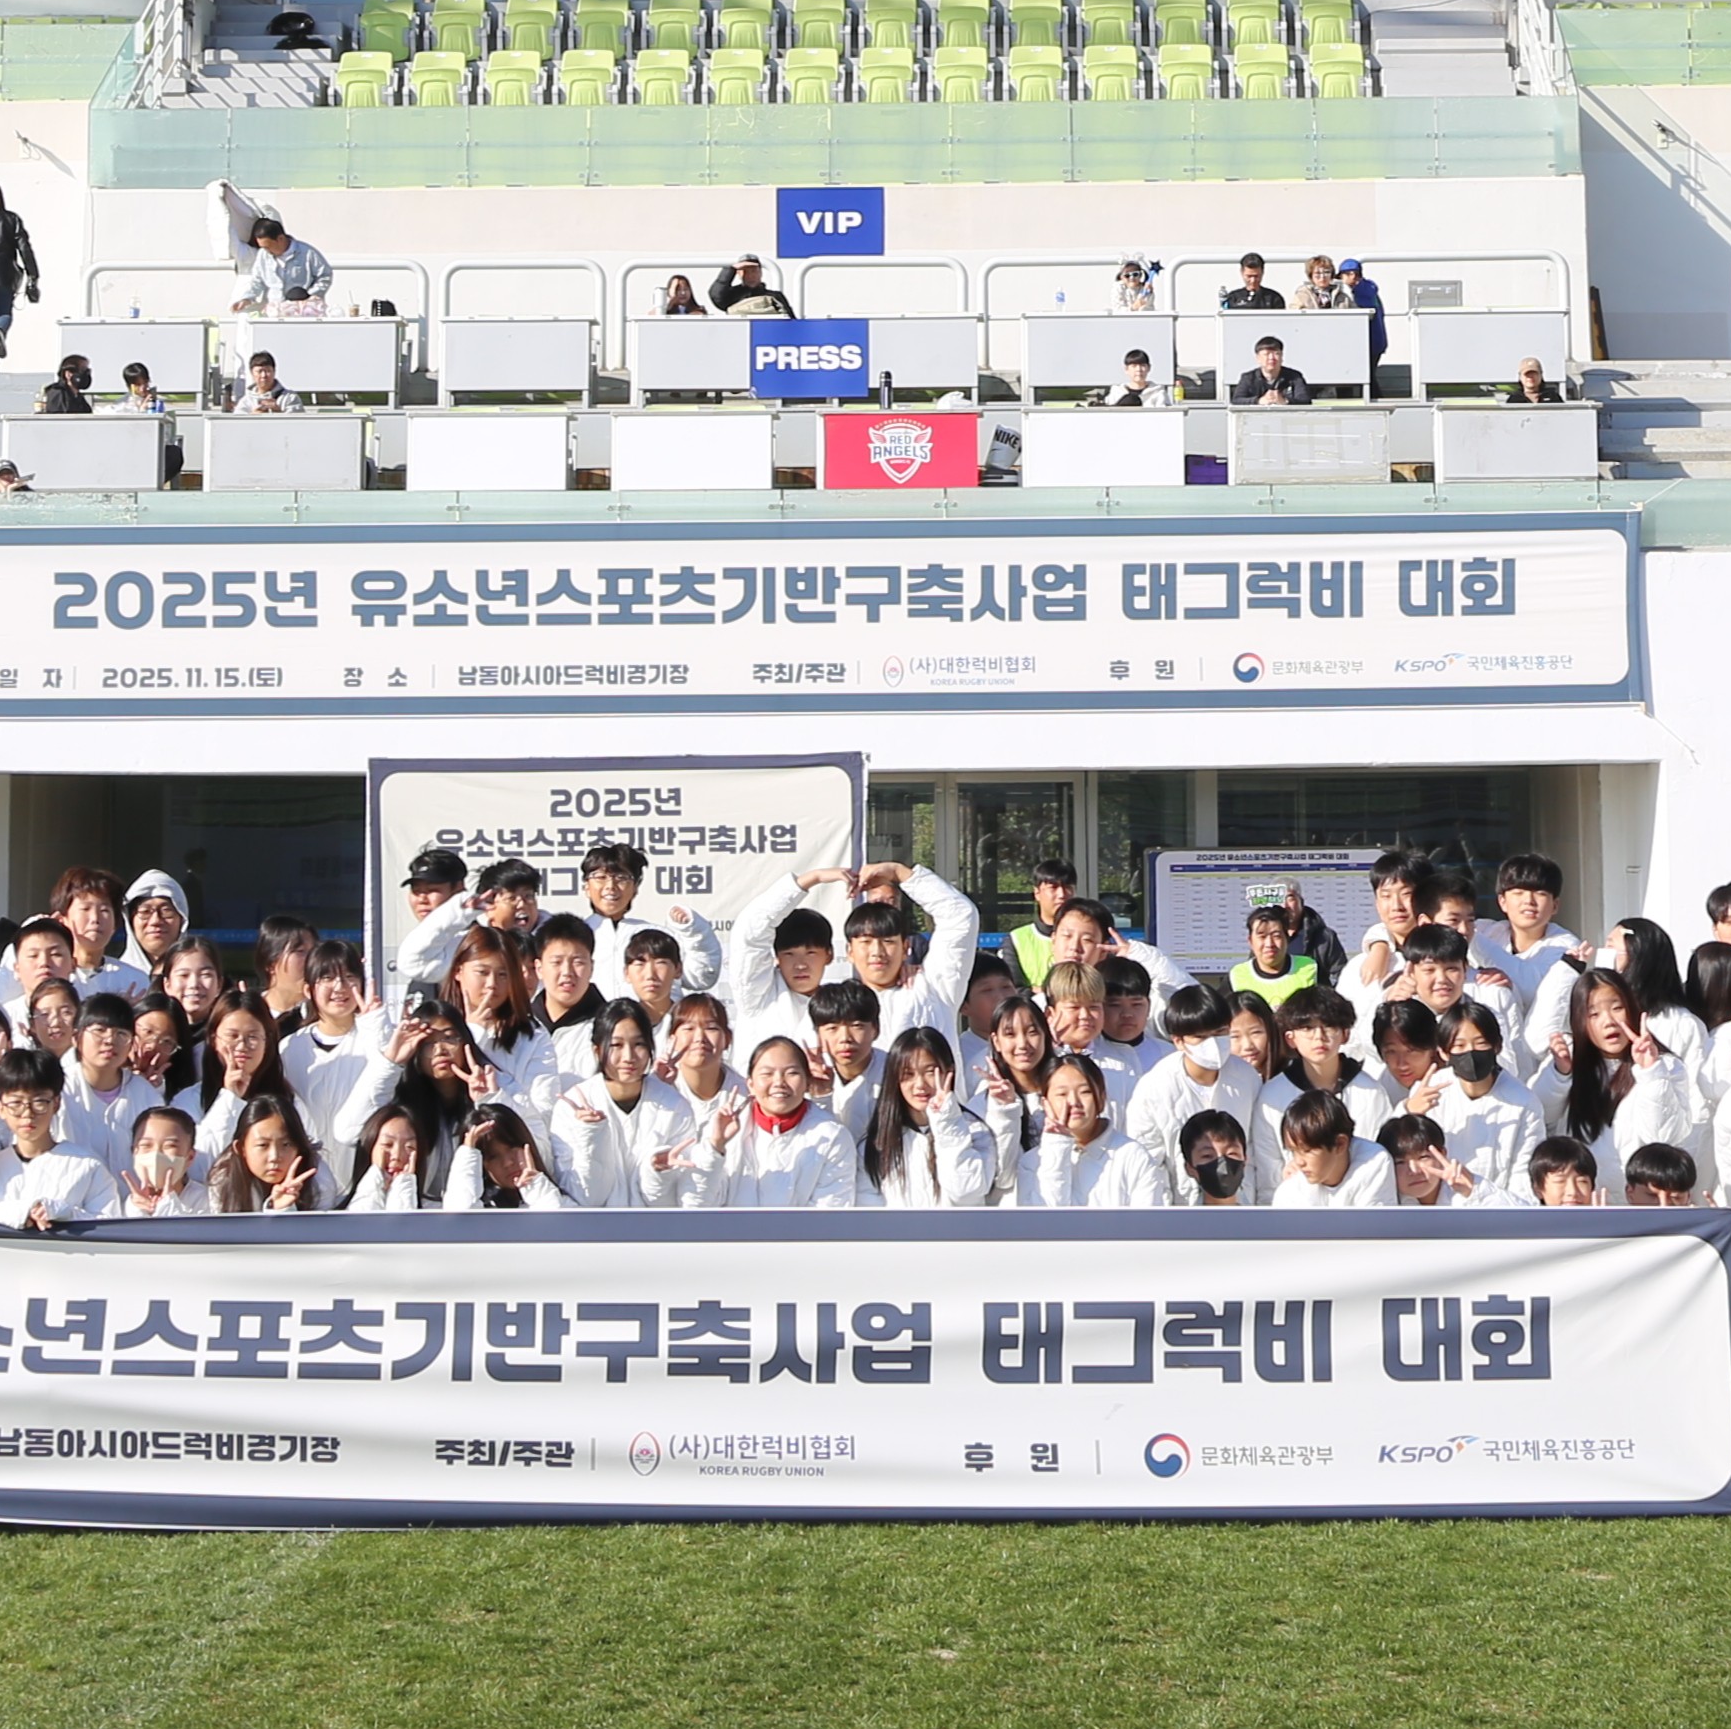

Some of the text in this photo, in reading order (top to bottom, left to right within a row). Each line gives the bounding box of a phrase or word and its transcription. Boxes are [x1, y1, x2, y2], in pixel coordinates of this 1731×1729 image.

[797, 212, 862, 234] VIP
[755, 344, 863, 370] PRESS
[889, 435, 912, 445] RED
[994, 428, 1020, 449] NIKE
[873, 445, 929, 461] ANGELS
[54, 556, 1515, 630] 2025년 유소년스포츠기반구축사업 태그럭비 대회
[458, 664, 690, 686] 남동아시아드럭비경기장
[752, 662, 847, 684] 주최/주관
[910, 655, 1036, 674] (사)대한럭비협회
[1272, 660, 1364, 676] 문화체육관광부
[1394, 659, 1447, 673] KSPO
[1467, 654, 1573, 671] 국민체육진흥공단
[550, 787, 682, 818] 2025년
[656, 865, 713, 895] 대회
[981, 1299, 1334, 1385] 태그럭비
[1381, 1295, 1552, 1382] 대회
[435, 1439, 575, 1468] 주최/주관
[669, 1434, 855, 1461] (사)대한럭비협회
[1201, 1445, 1334, 1467] 문화체육관광부
[1378, 1444, 1454, 1463] KSPO
[1482, 1438, 1636, 1462] 국민체육진흥공단
[699, 1465, 825, 1477] KOREA RUGBY UNION
